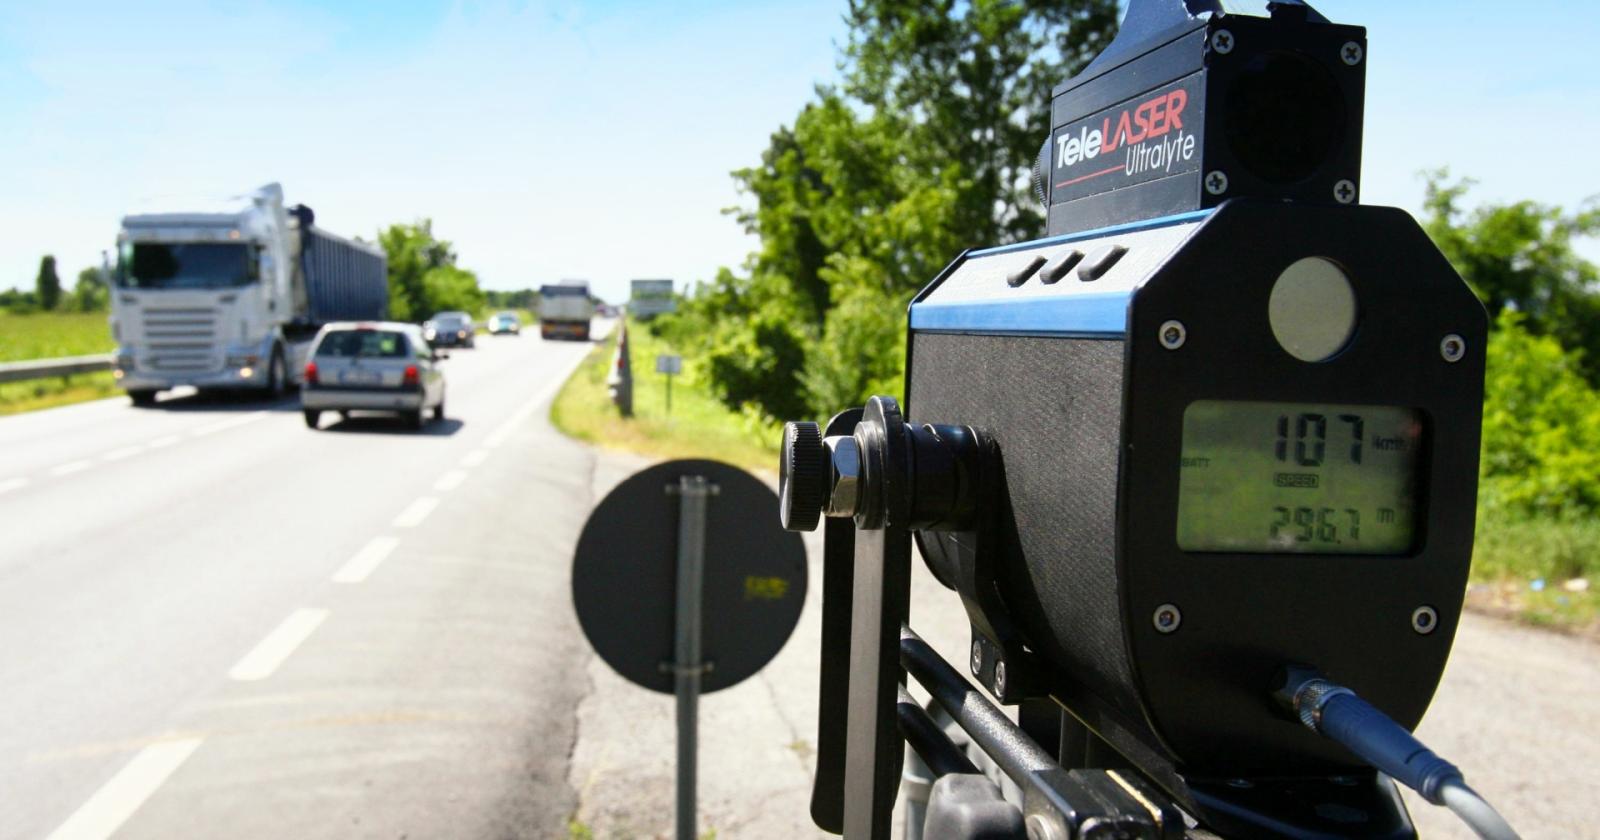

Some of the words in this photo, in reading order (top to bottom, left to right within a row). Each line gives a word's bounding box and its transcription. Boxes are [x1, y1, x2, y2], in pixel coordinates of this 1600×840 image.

[1057, 89, 1188, 169] TeleLASER
[1126, 129, 1195, 177] Ultralyte
[1276, 413, 1364, 467] 107
[1276, 473, 1318, 488] SPEED
[1270, 506, 1360, 544] 296.7
[1376, 507, 1395, 524] m
